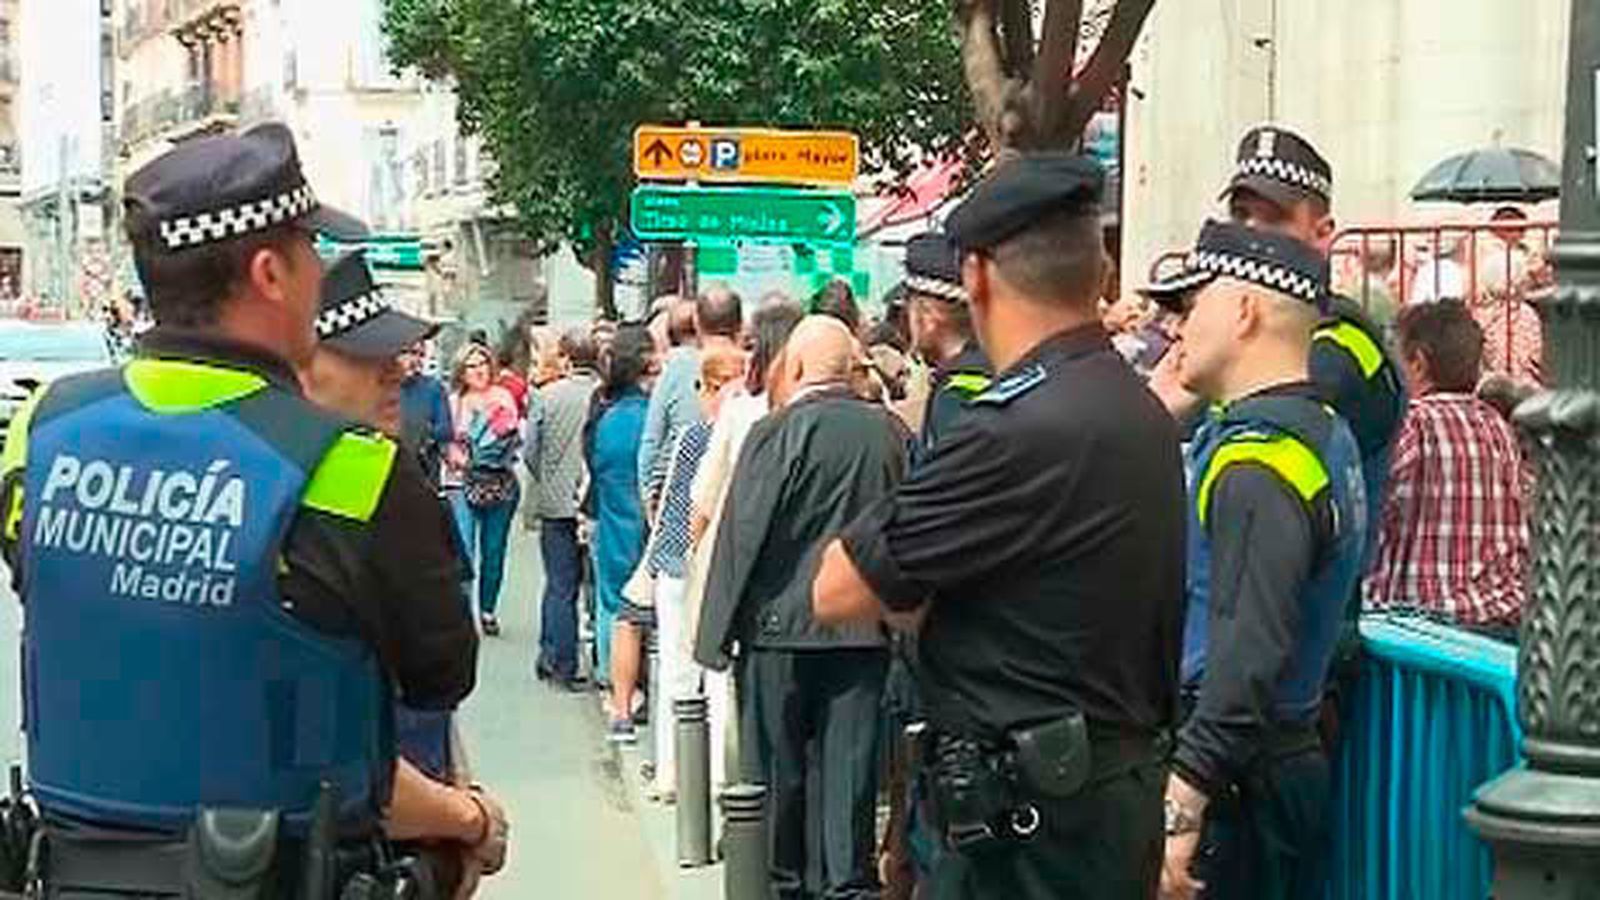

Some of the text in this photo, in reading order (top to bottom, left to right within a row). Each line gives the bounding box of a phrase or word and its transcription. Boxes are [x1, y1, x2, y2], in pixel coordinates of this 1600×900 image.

[41, 454, 245, 527] POLICÍA
[34, 506, 236, 571] MUNICIPAL
[110, 562, 235, 606] Madrid
